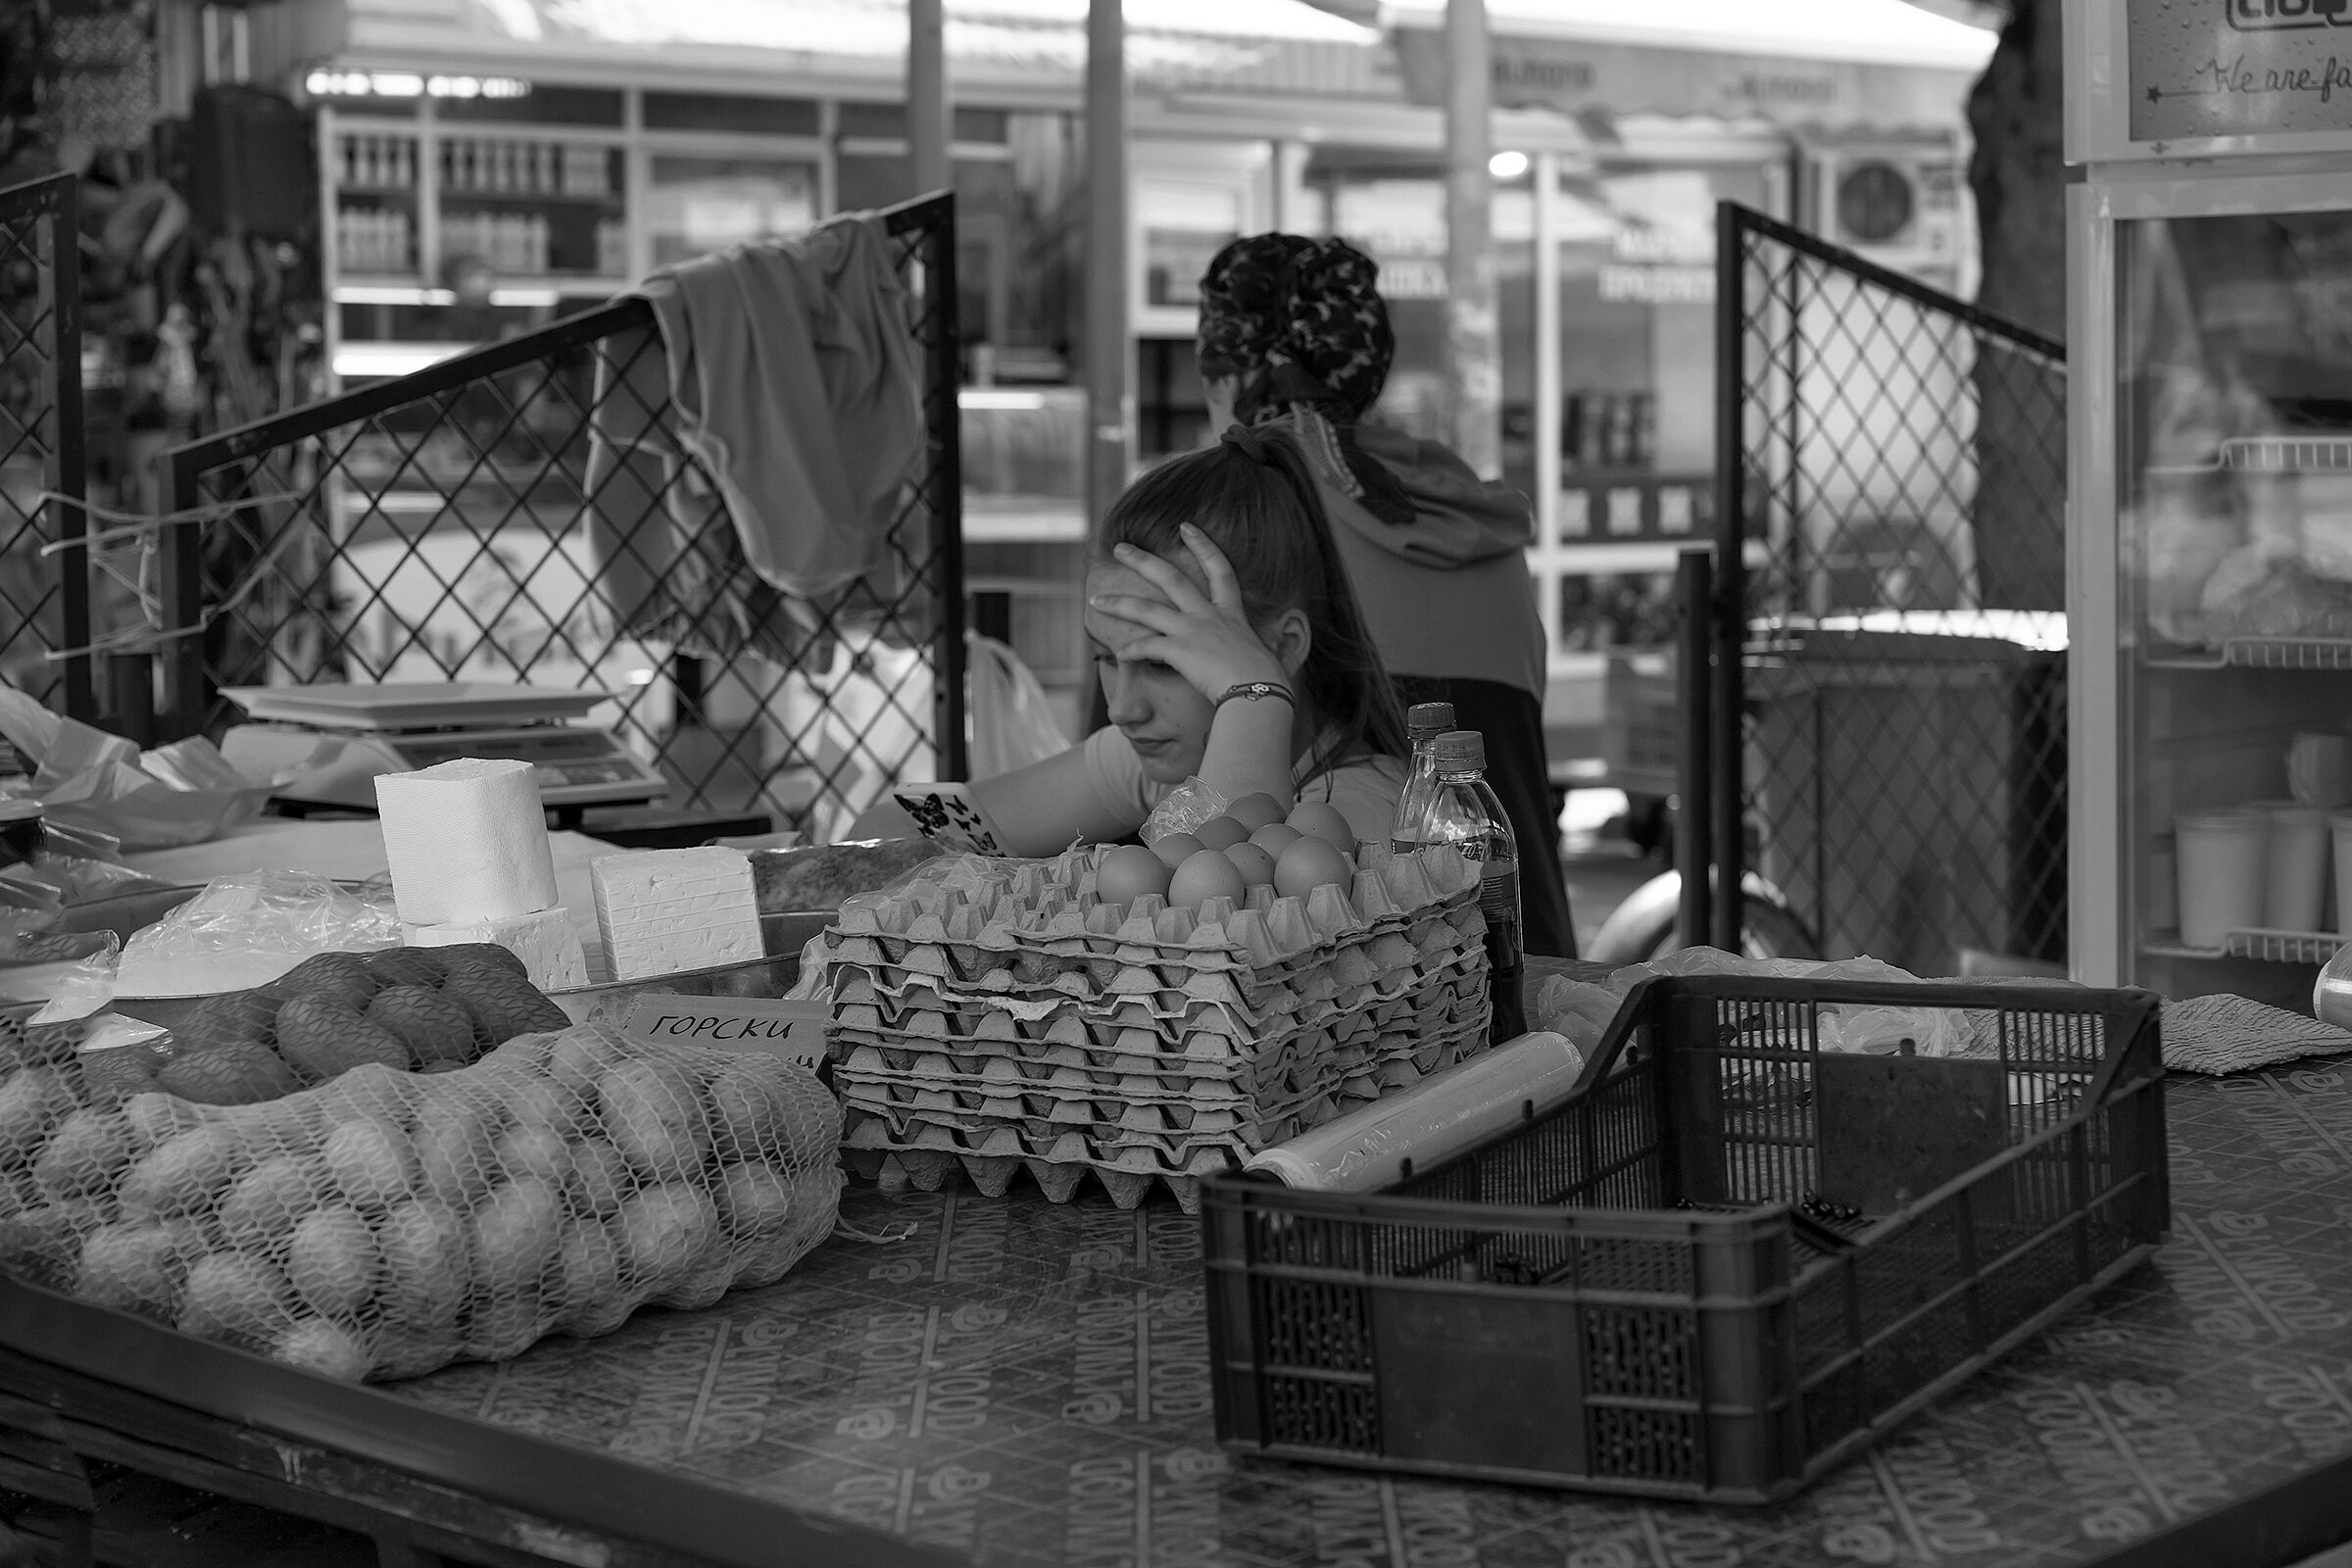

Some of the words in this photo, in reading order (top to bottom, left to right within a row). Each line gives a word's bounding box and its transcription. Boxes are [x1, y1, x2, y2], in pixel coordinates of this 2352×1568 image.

[2204, 55, 2255, 94] We
[2265, 69, 2312, 92] are
[649, 1015, 794, 1039] ГОРСКИ
